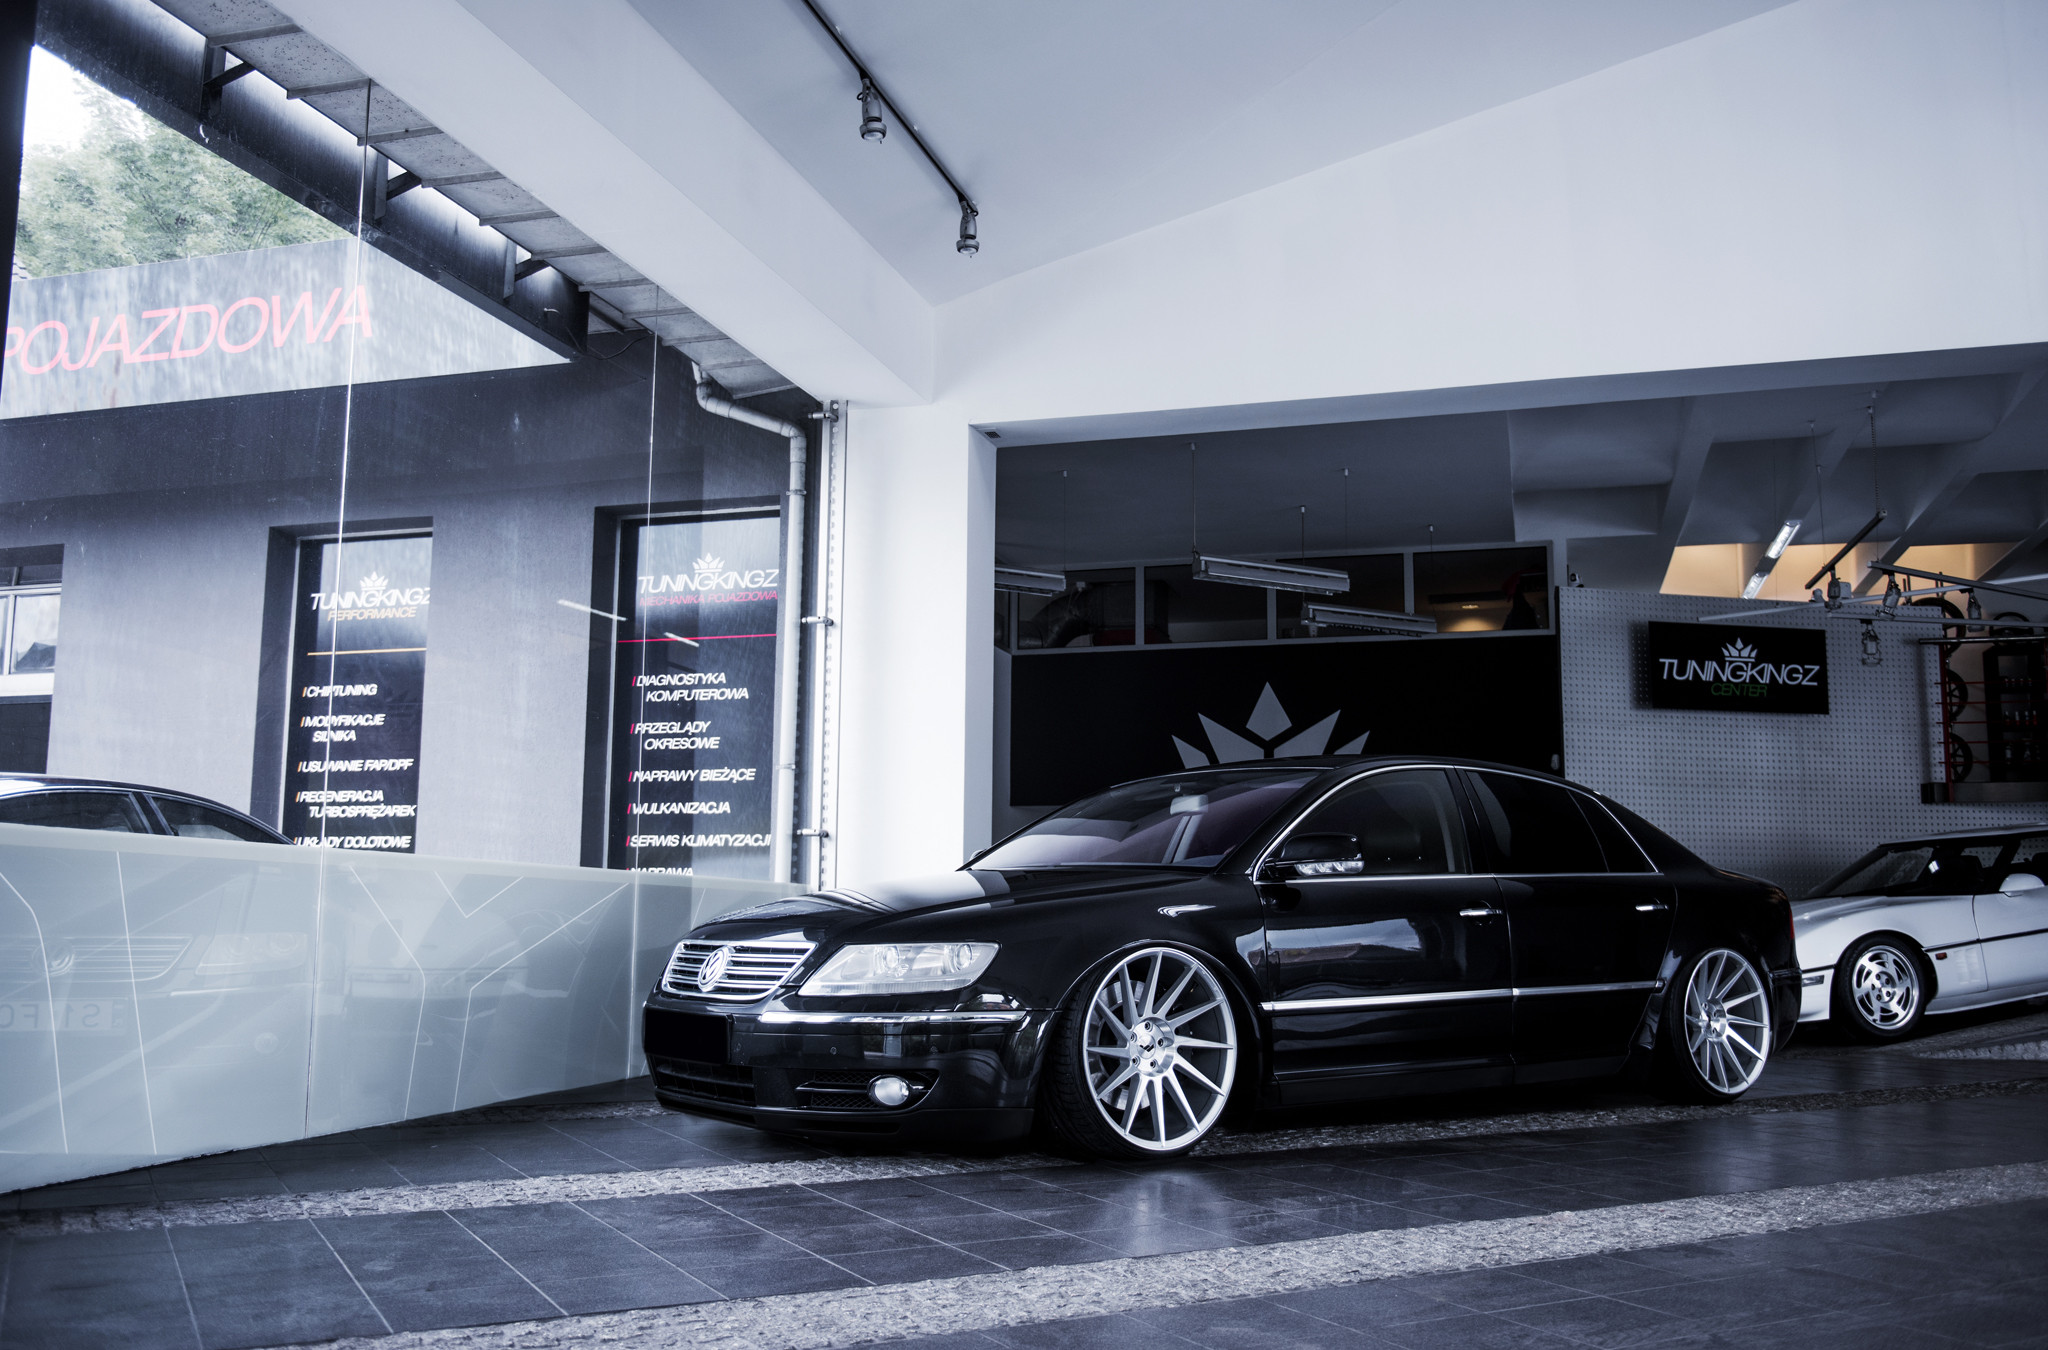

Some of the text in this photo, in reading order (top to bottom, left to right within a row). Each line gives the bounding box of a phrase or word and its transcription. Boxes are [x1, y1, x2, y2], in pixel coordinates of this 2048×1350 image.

[638, 569, 779, 594] TUNINGKINGZ
[310, 587, 431, 610] TUNINGKINGZ
[640, 590, 778, 607] MECHANIKA POJAZDOWA
[328, 606, 417, 621] PERFORMANCE
[1659, 658, 1820, 686] TUNINGKINGZ
[636, 672, 726, 687] DIAGNOSTYKA
[306, 684, 378, 697] CHIPTUNING
[646, 688, 749, 702] KOMPUTEROWA
[1711, 682, 1767, 697] CENTER
[304, 714, 386, 727] MODYFIKACJE
[635, 721, 711, 735] PRZEGLĄDY
[312, 730, 356, 742] SILNIKA
[644, 737, 720, 750] OKRESOWE
[302, 759, 414, 772] USUWANIE FAP/DPF
[633, 766, 756, 783] NAPRAWY BIEŻĄCE
[300, 790, 384, 802] REGENERACJA
[309, 803, 417, 819] TURBOSPRĘŻAREK
[632, 801, 731, 815] WULKANIZACJA
[344, 836, 412, 849] DOLOTOWE
[630, 833, 772, 847] SERWIS KLIMATYZACJI
